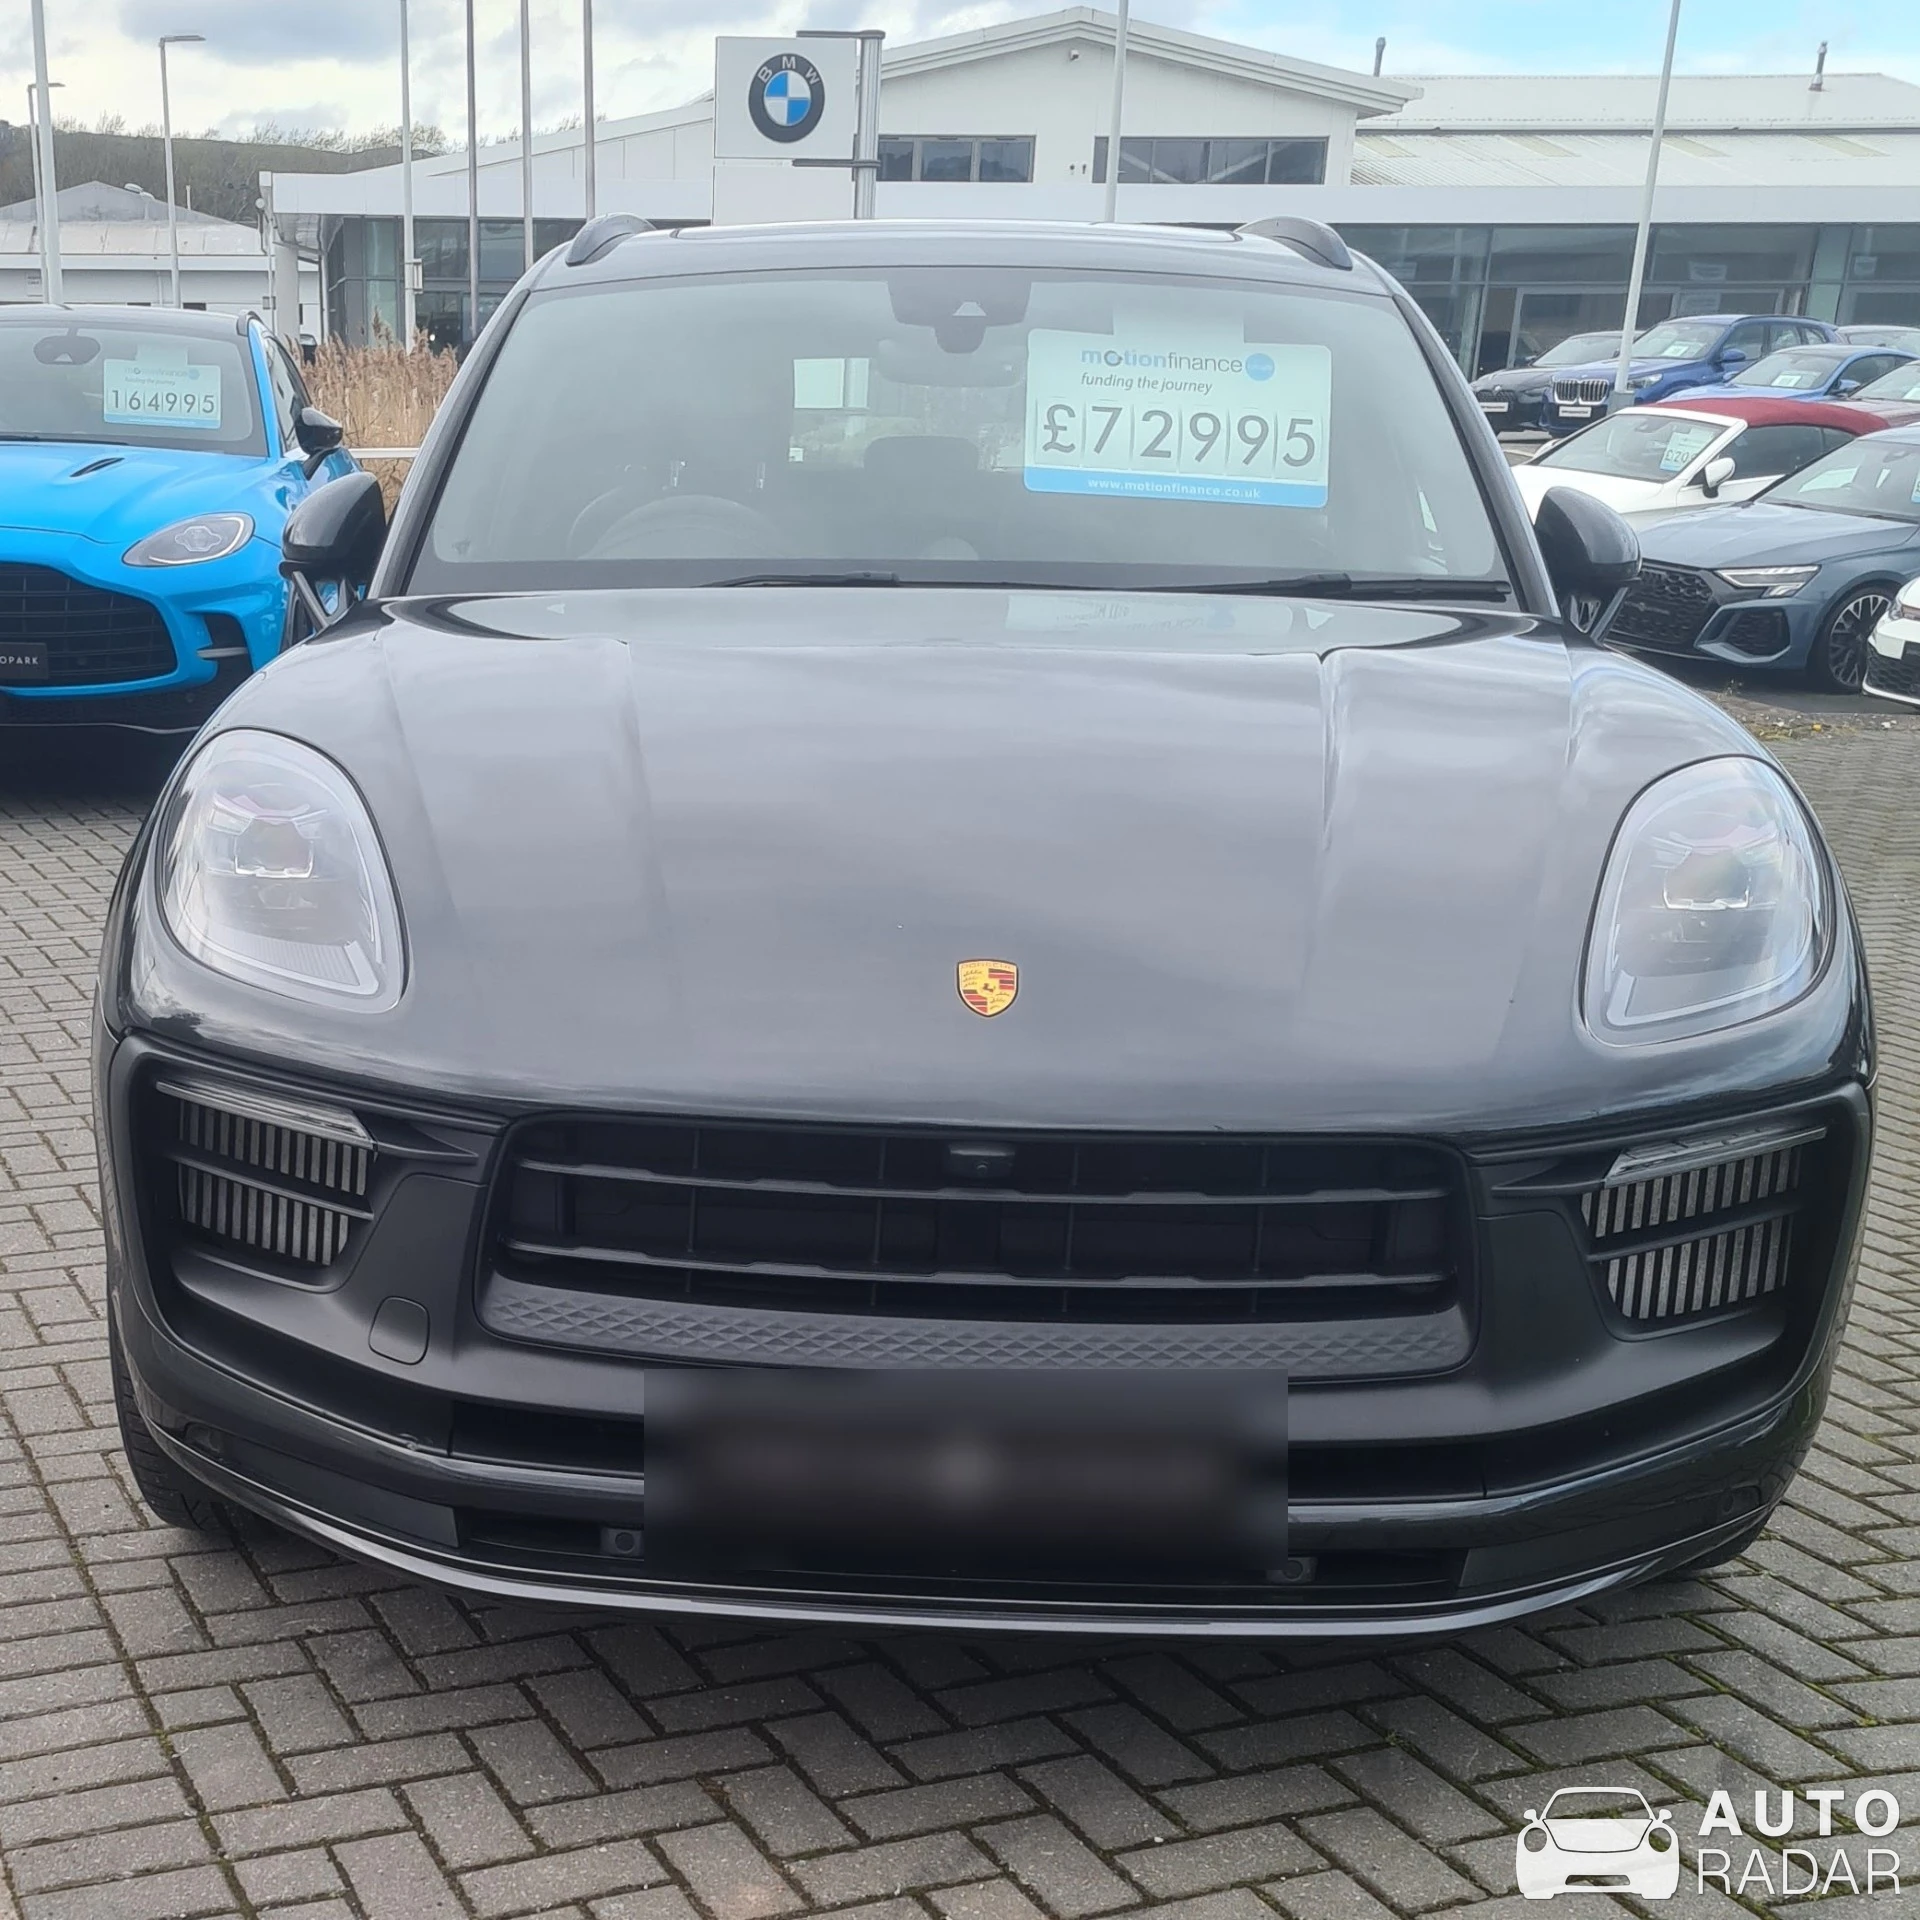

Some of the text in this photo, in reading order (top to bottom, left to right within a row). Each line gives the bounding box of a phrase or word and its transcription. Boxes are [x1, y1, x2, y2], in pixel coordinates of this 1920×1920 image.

[757, 55, 820, 85] BMW
[1081, 350, 1243, 373] motionfinance
[1081, 372, 1213, 395] funding the journey
[112, 389, 215, 414] 164995
[1042, 403, 1316, 468] £72995
[1087, 477, 1261, 500] www.motionfinance.co.uk
